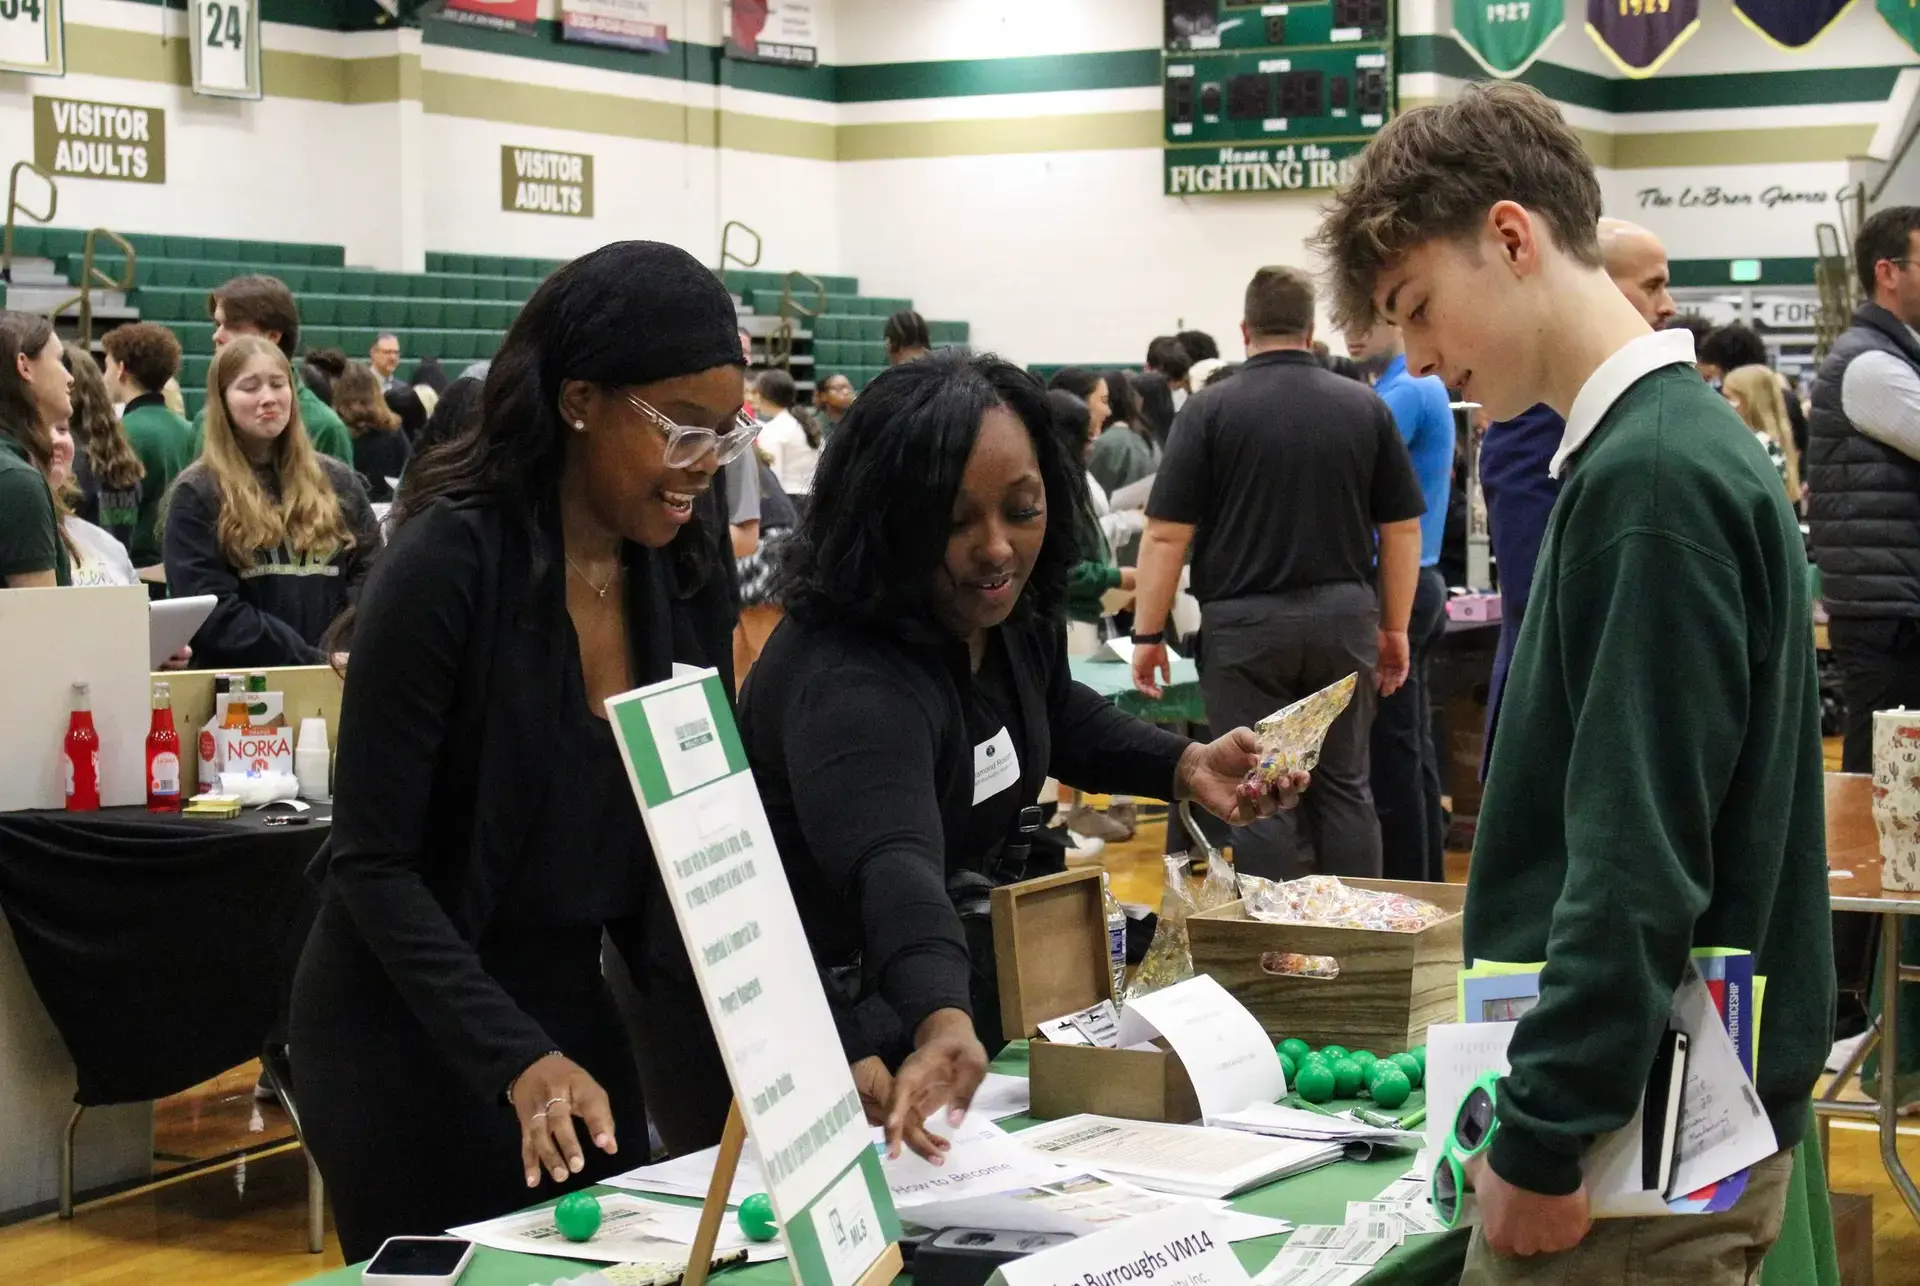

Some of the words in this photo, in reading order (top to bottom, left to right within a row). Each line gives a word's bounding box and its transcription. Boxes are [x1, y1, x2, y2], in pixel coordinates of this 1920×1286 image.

[207, 2, 241, 50] 24
[51, 101, 149, 141] VISITOR
[55, 140, 149, 178] ADULTS
[513, 148, 583, 183] VISITOR
[1219, 148, 1269, 164] Home
[1276, 144, 1296, 166] of
[1301, 144, 1331, 161] the
[1170, 160, 1303, 193] FIGHTING
[515, 181, 582, 214] ADULTS
[1635, 187, 1673, 209] The
[228, 738, 291, 762] NORKA
[891, 1181, 929, 1196] How
[929, 1178, 949, 1188] to
[948, 1163, 1013, 1182] Become
[850, 1217, 867, 1248] MLS
[1163, 1230, 1215, 1263] VM14
